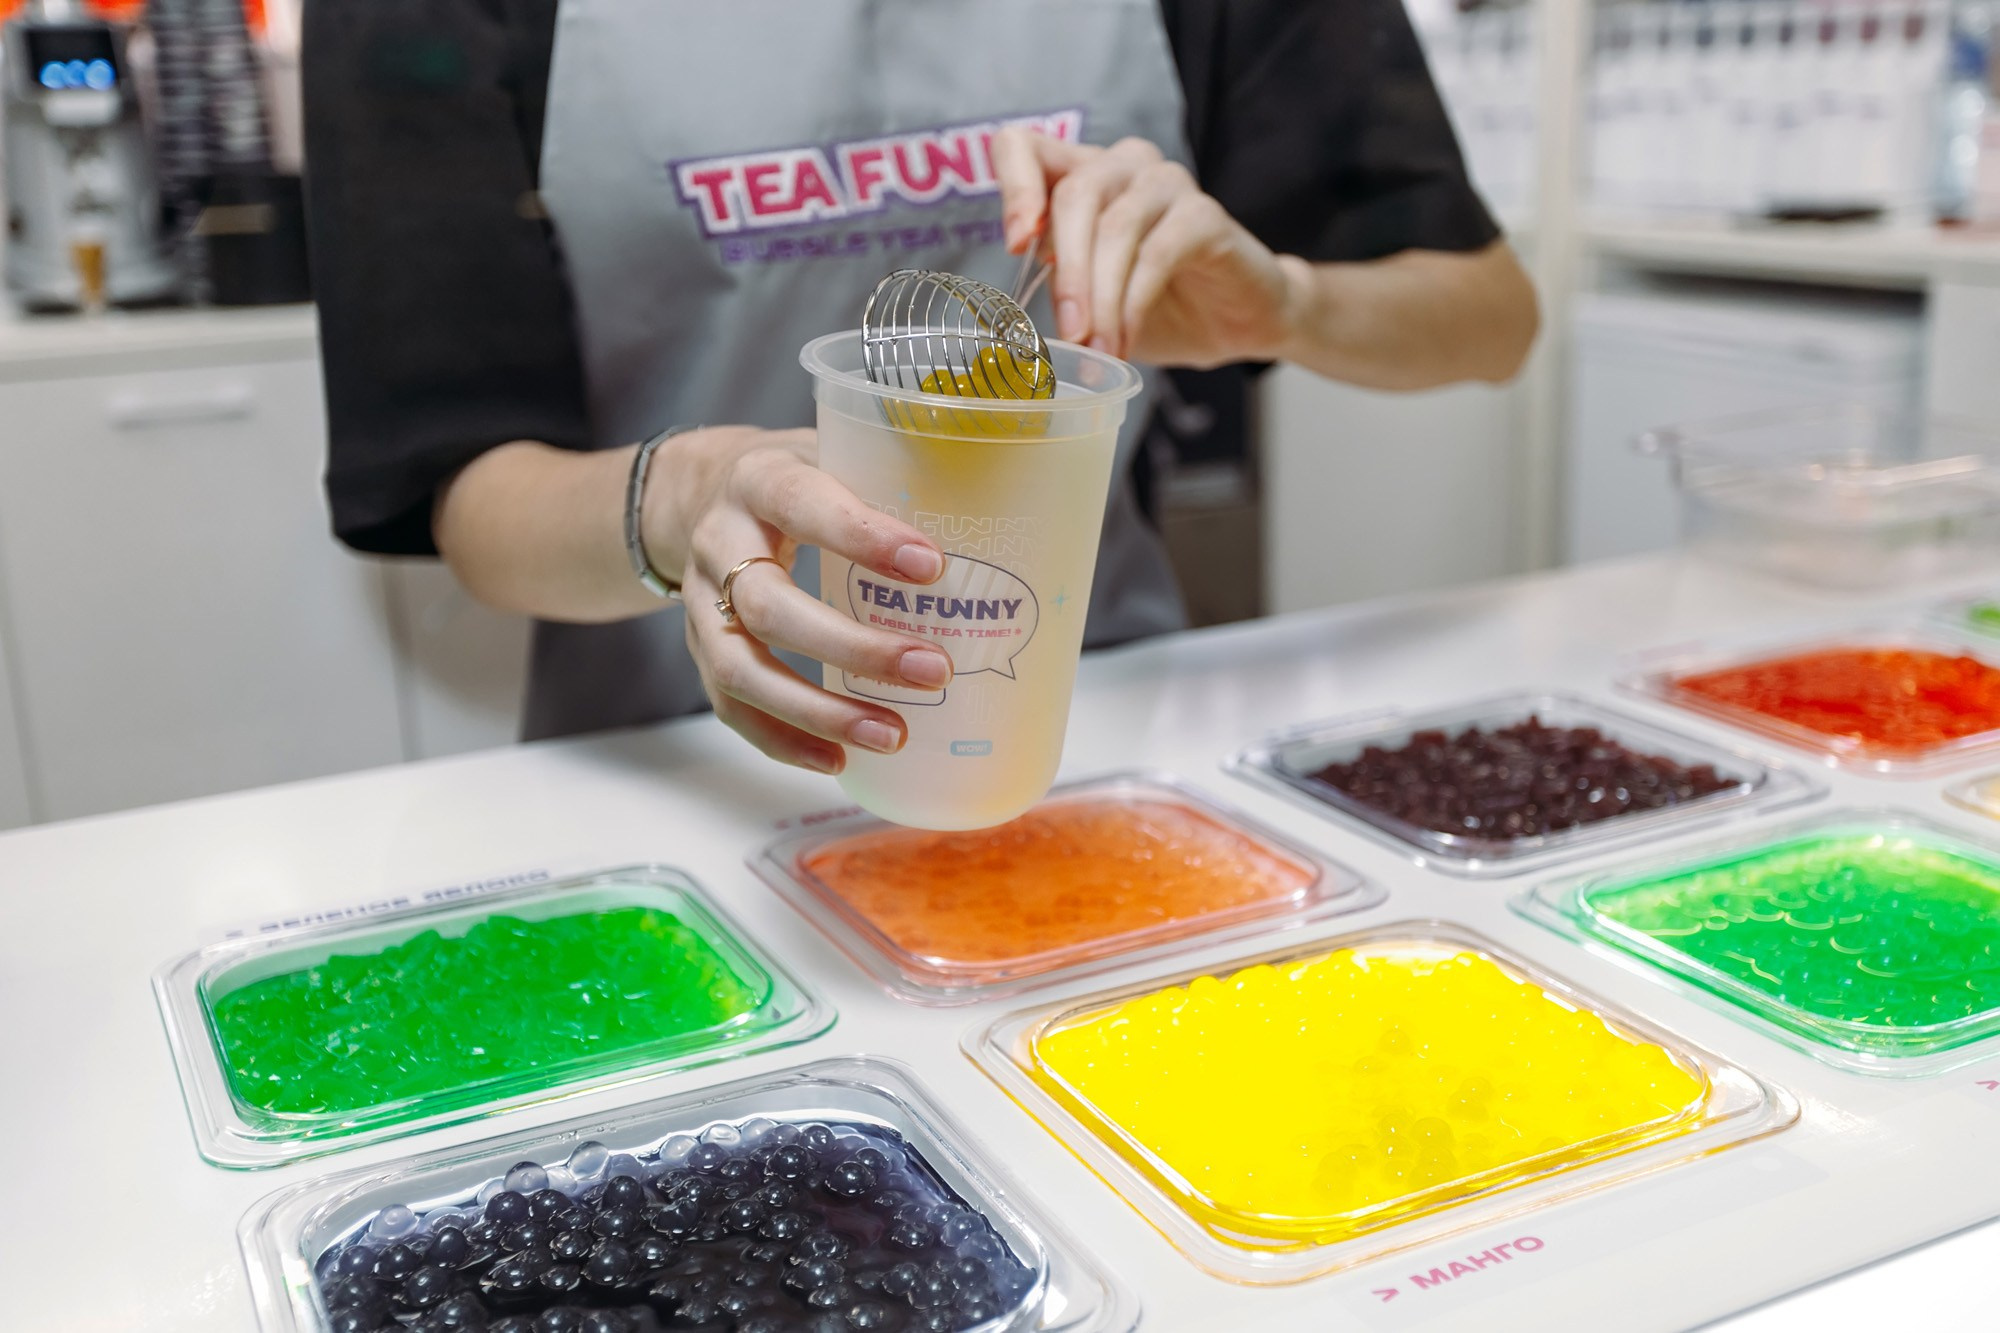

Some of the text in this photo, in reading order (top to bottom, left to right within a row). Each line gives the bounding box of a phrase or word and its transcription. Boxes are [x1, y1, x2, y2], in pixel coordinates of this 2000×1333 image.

[692, 159, 837, 221] TEA
[858, 579, 1023, 621] TEA FUNNY
[869, 613, 1012, 638] BUBBLE TEA TIME!
[1409, 1236, 1545, 1290] МАНГО
